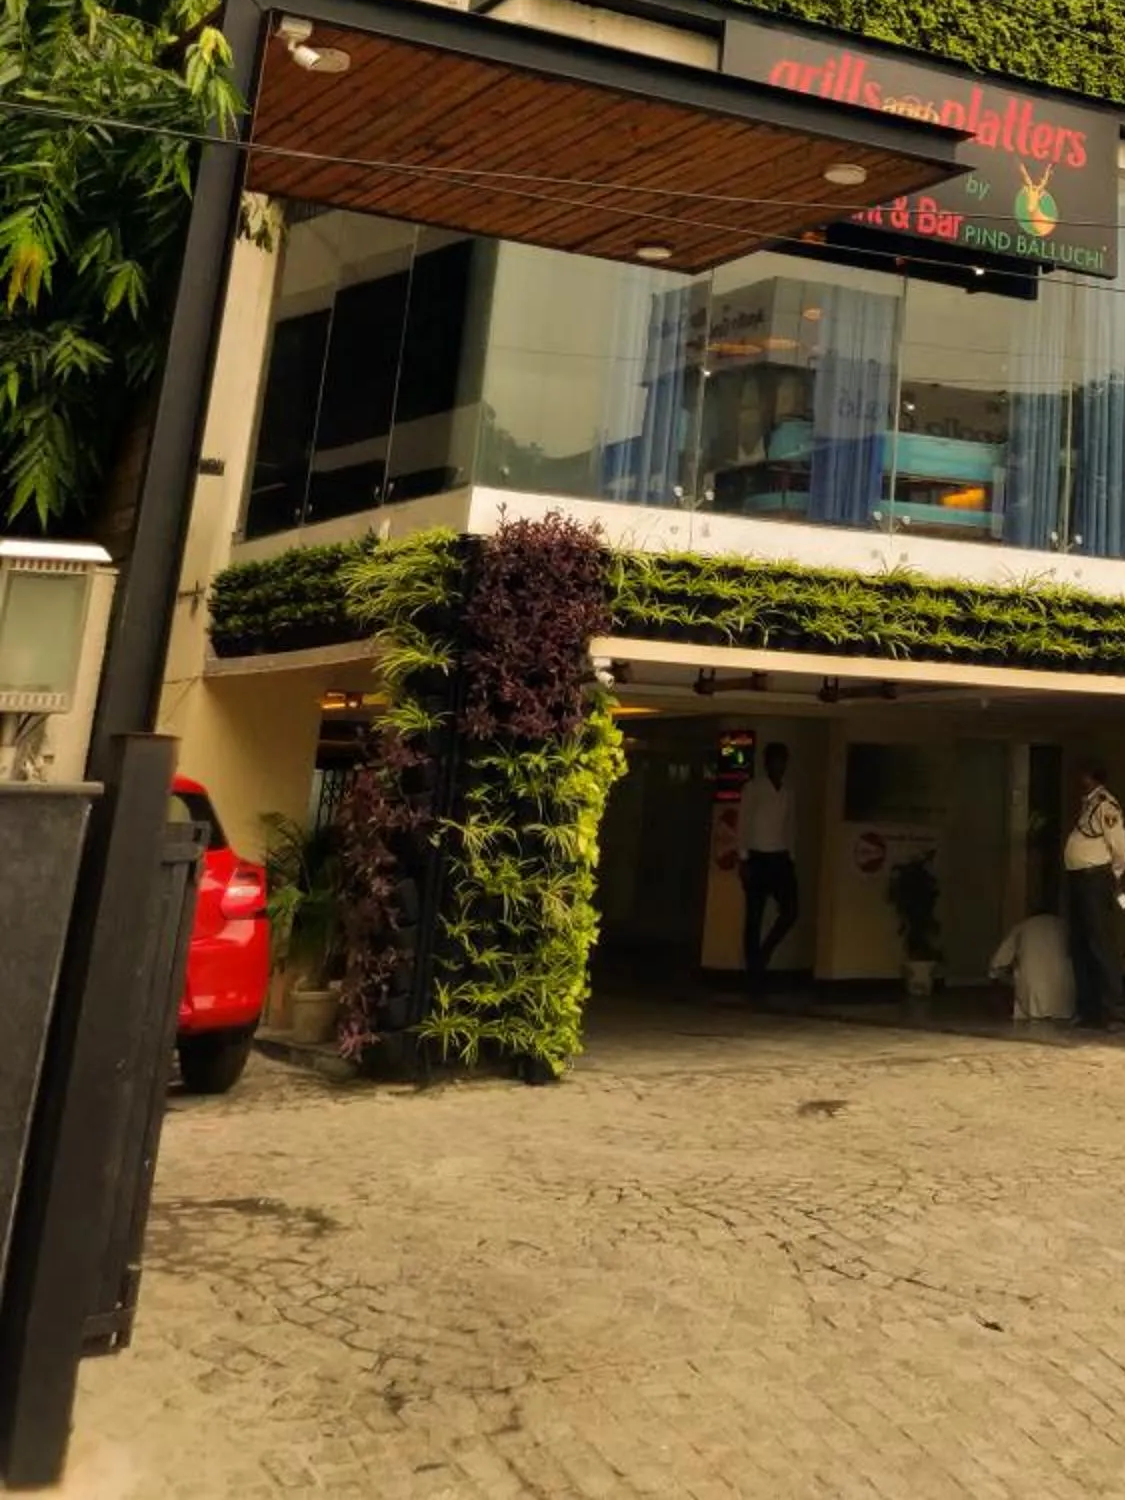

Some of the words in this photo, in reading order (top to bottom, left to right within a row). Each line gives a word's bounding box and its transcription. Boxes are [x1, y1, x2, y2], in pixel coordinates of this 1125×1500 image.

[965, 174, 991, 202] by
[915, 195, 967, 242] Bar
[965, 223, 1012, 252] PIND
[1015, 236, 1103, 270] BALLUCHI
